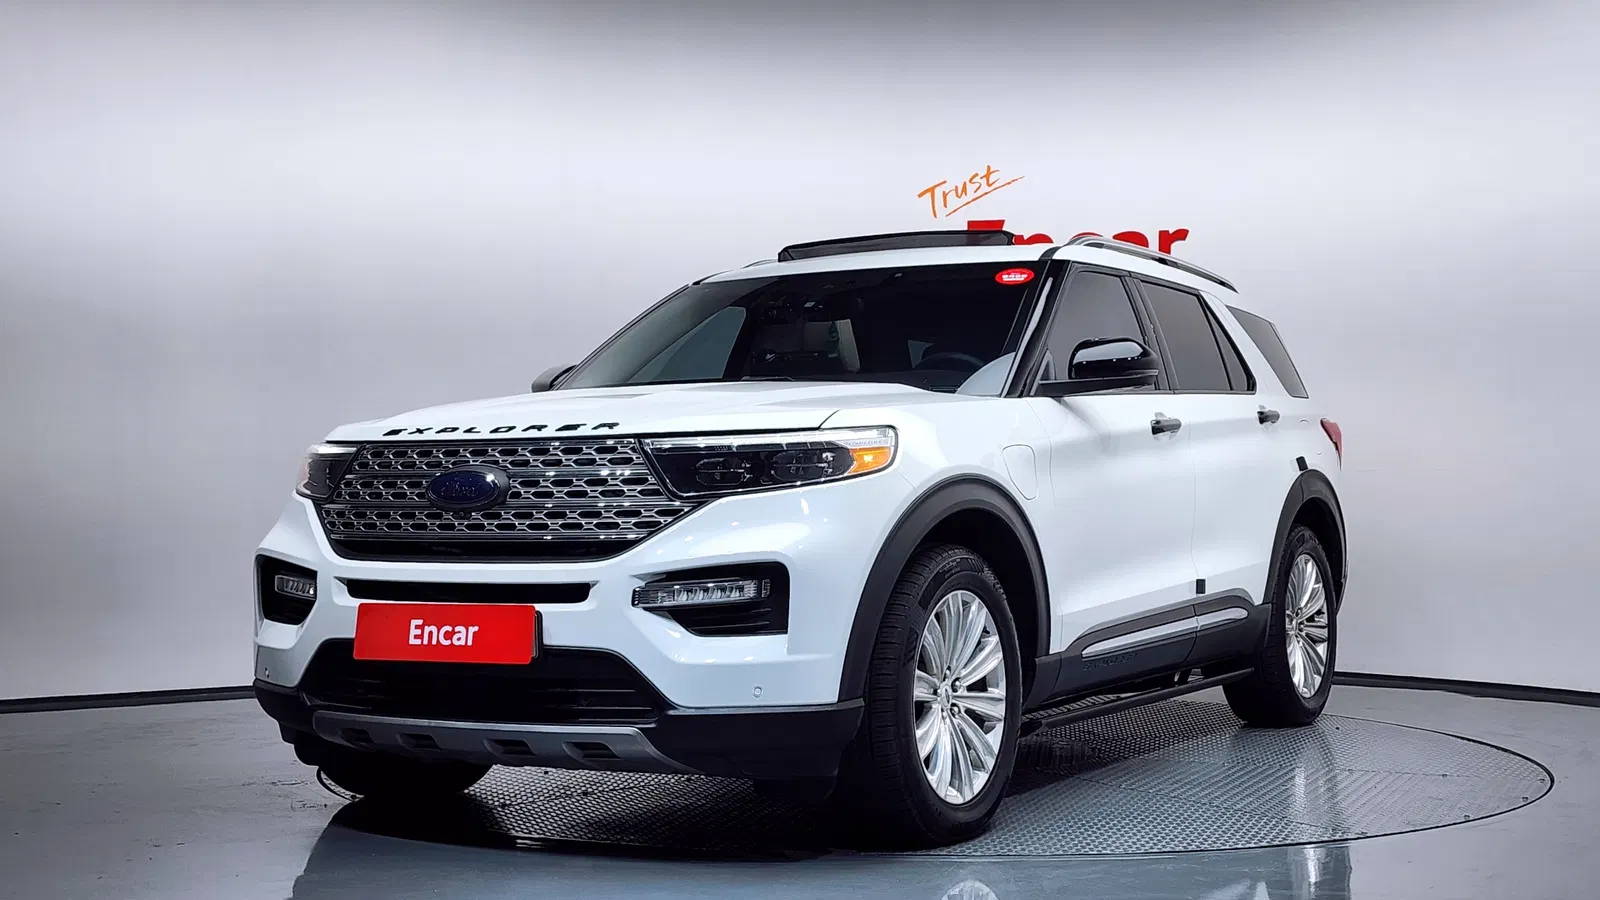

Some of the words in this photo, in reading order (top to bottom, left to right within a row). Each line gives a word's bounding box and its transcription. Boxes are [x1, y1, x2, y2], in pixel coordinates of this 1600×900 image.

[917, 165, 1000, 218] Trust
[382, 422, 620, 437] EXPLORER
[408, 619, 479, 647] Encar
